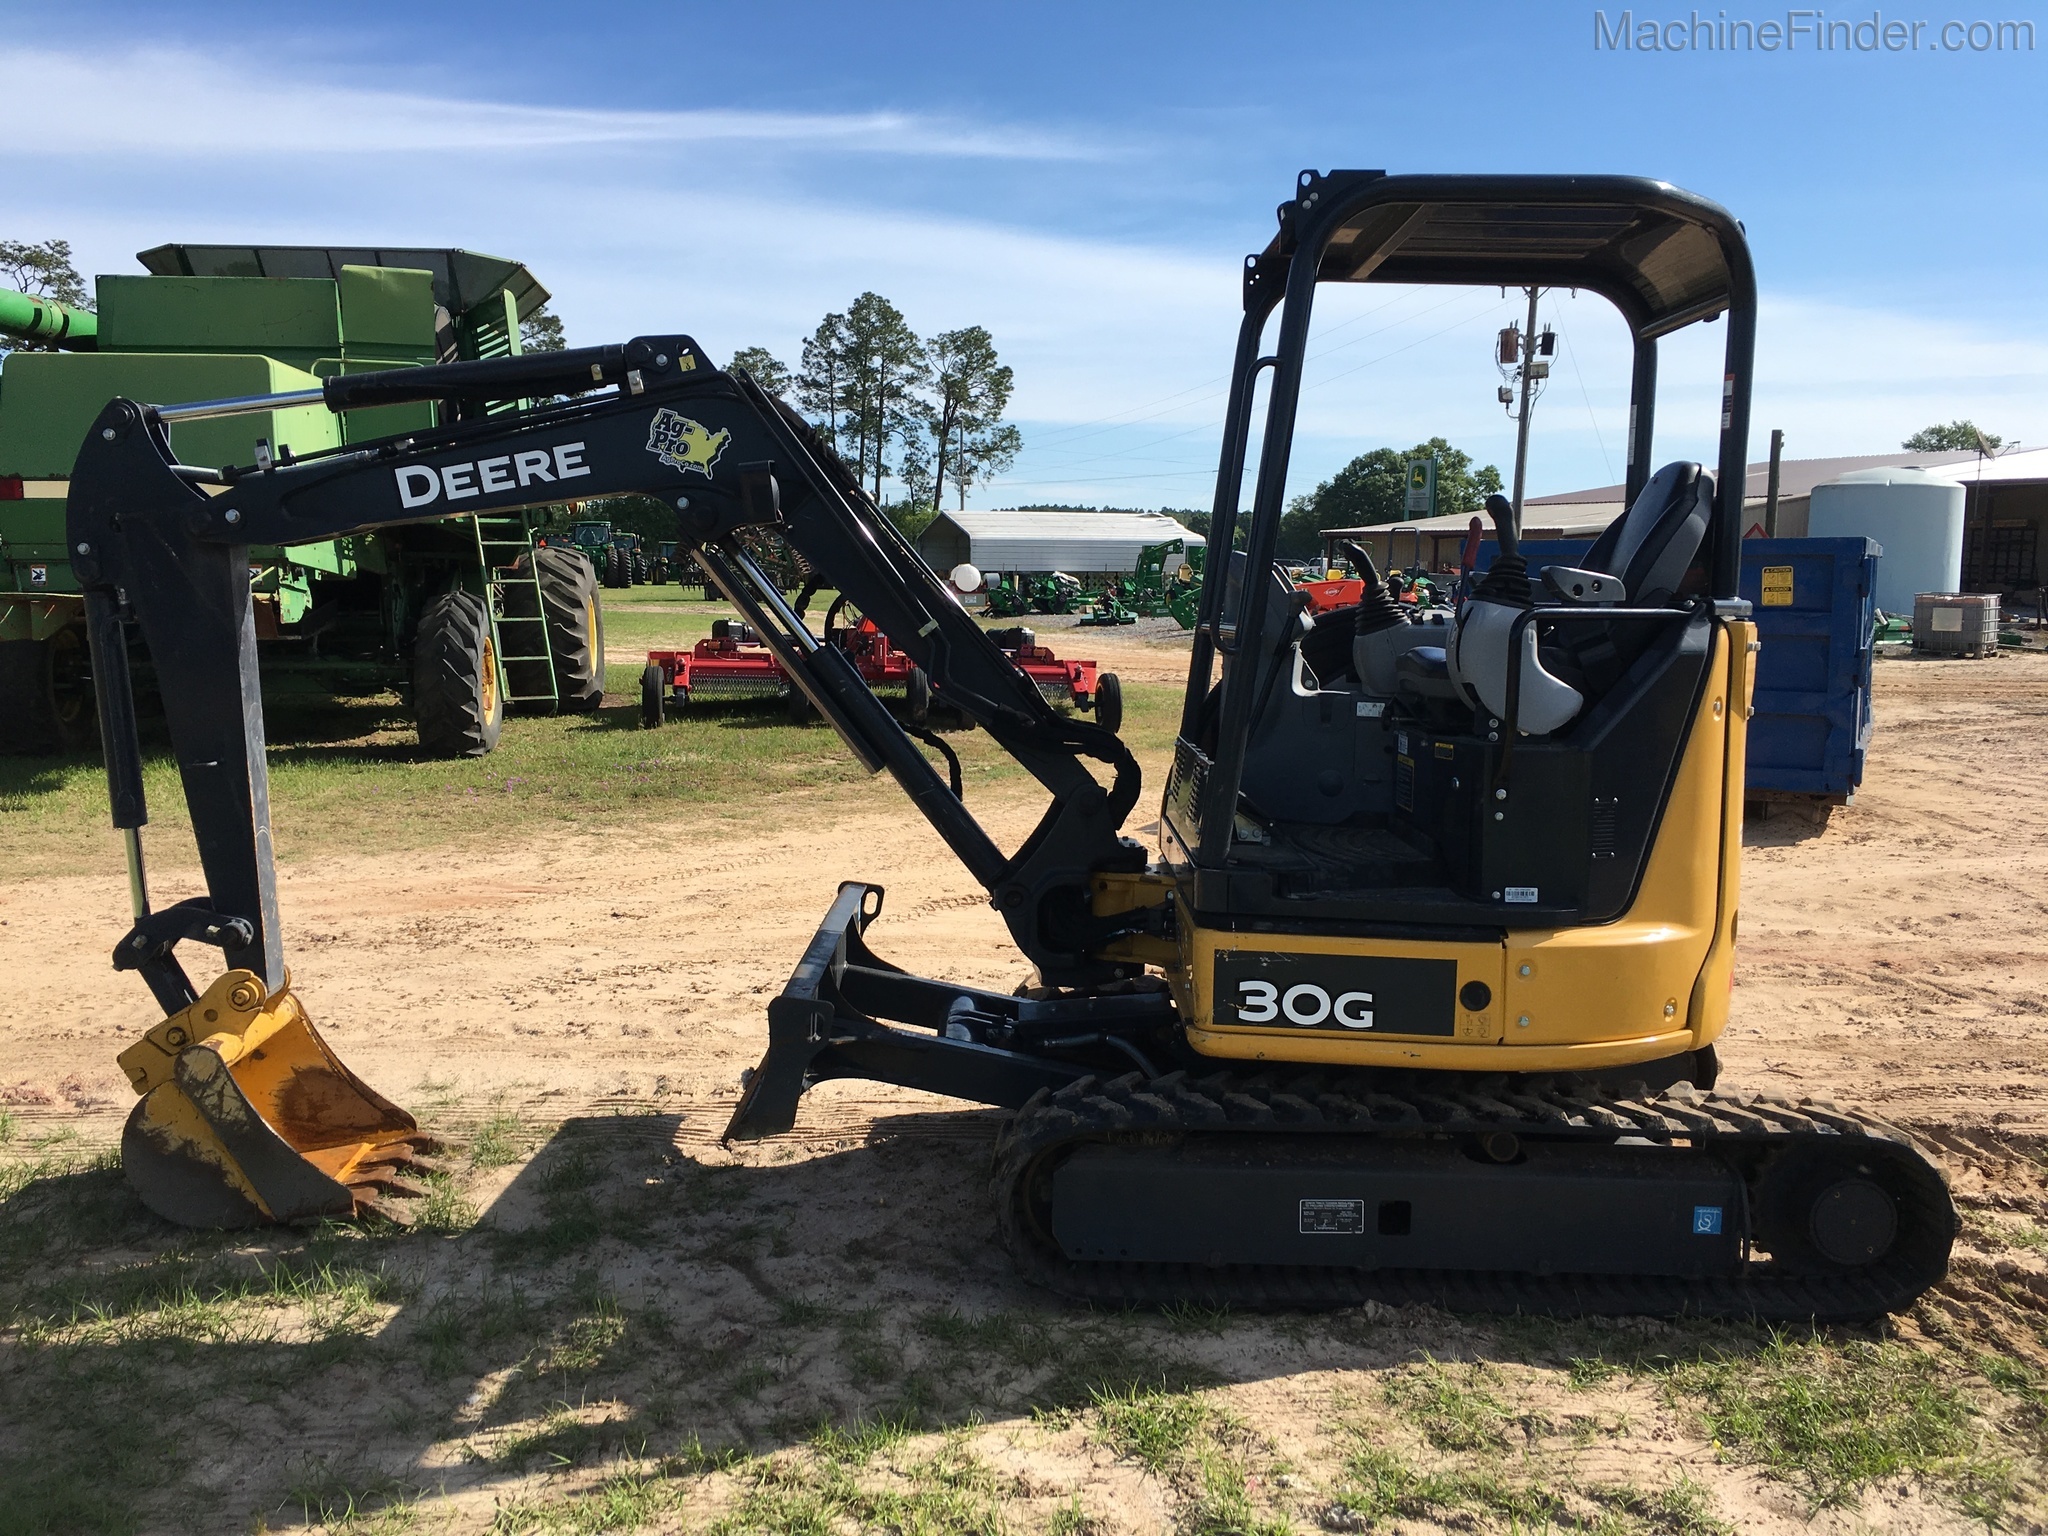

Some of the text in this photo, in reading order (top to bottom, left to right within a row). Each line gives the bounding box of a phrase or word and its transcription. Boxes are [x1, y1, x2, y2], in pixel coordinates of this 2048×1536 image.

[649, 430, 690, 455] Pro
[653, 412, 694, 439] Ag-
[394, 441, 590, 508] DEERE
[1238, 980, 1373, 1029] 30G
